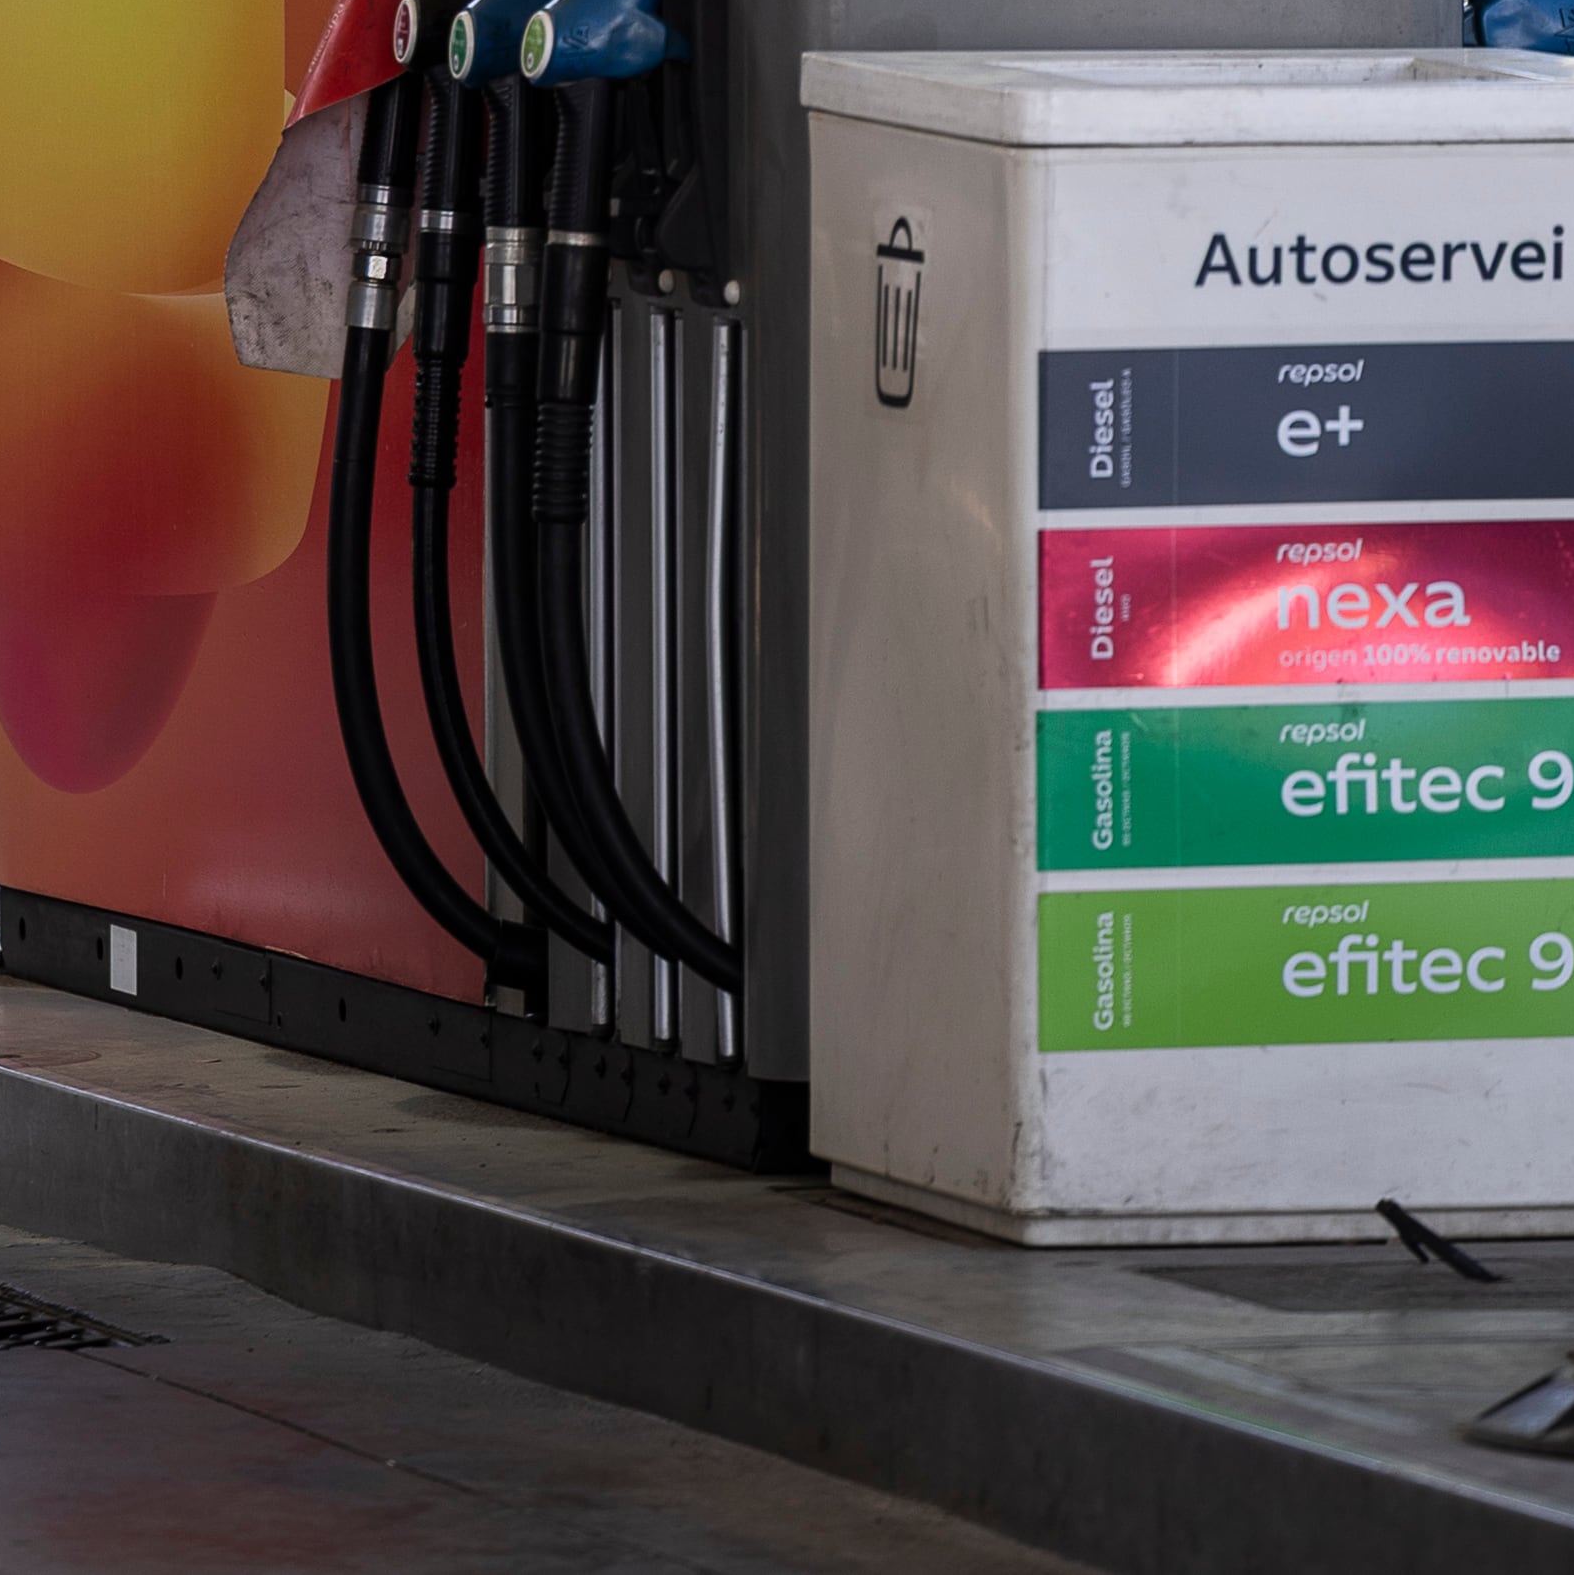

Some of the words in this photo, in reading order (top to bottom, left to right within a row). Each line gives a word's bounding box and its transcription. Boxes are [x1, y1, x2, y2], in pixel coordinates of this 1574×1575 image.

[1194, 224, 1565, 288] Autoservei
[1277, 359, 1364, 387] repsol
[1089, 378, 1114, 478] Diesel
[1277, 404, 1364, 457] e+
[1276, 538, 1363, 565] repsol
[1090, 556, 1114, 660] Diesel
[1277, 578, 1471, 630] nexa
[1280, 649, 1357, 671] origen
[1363, 644, 1431, 667] 100%
[1435, 640, 1561, 665] renovable
[1280, 719, 1365, 747] repsol
[1091, 729, 1113, 850] Gasolina
[1281, 753, 1506, 817] efitec
[1282, 900, 1369, 928] repsol
[1093, 911, 1114, 1031] Gasolina
[1282, 933, 1506, 998] efitec
